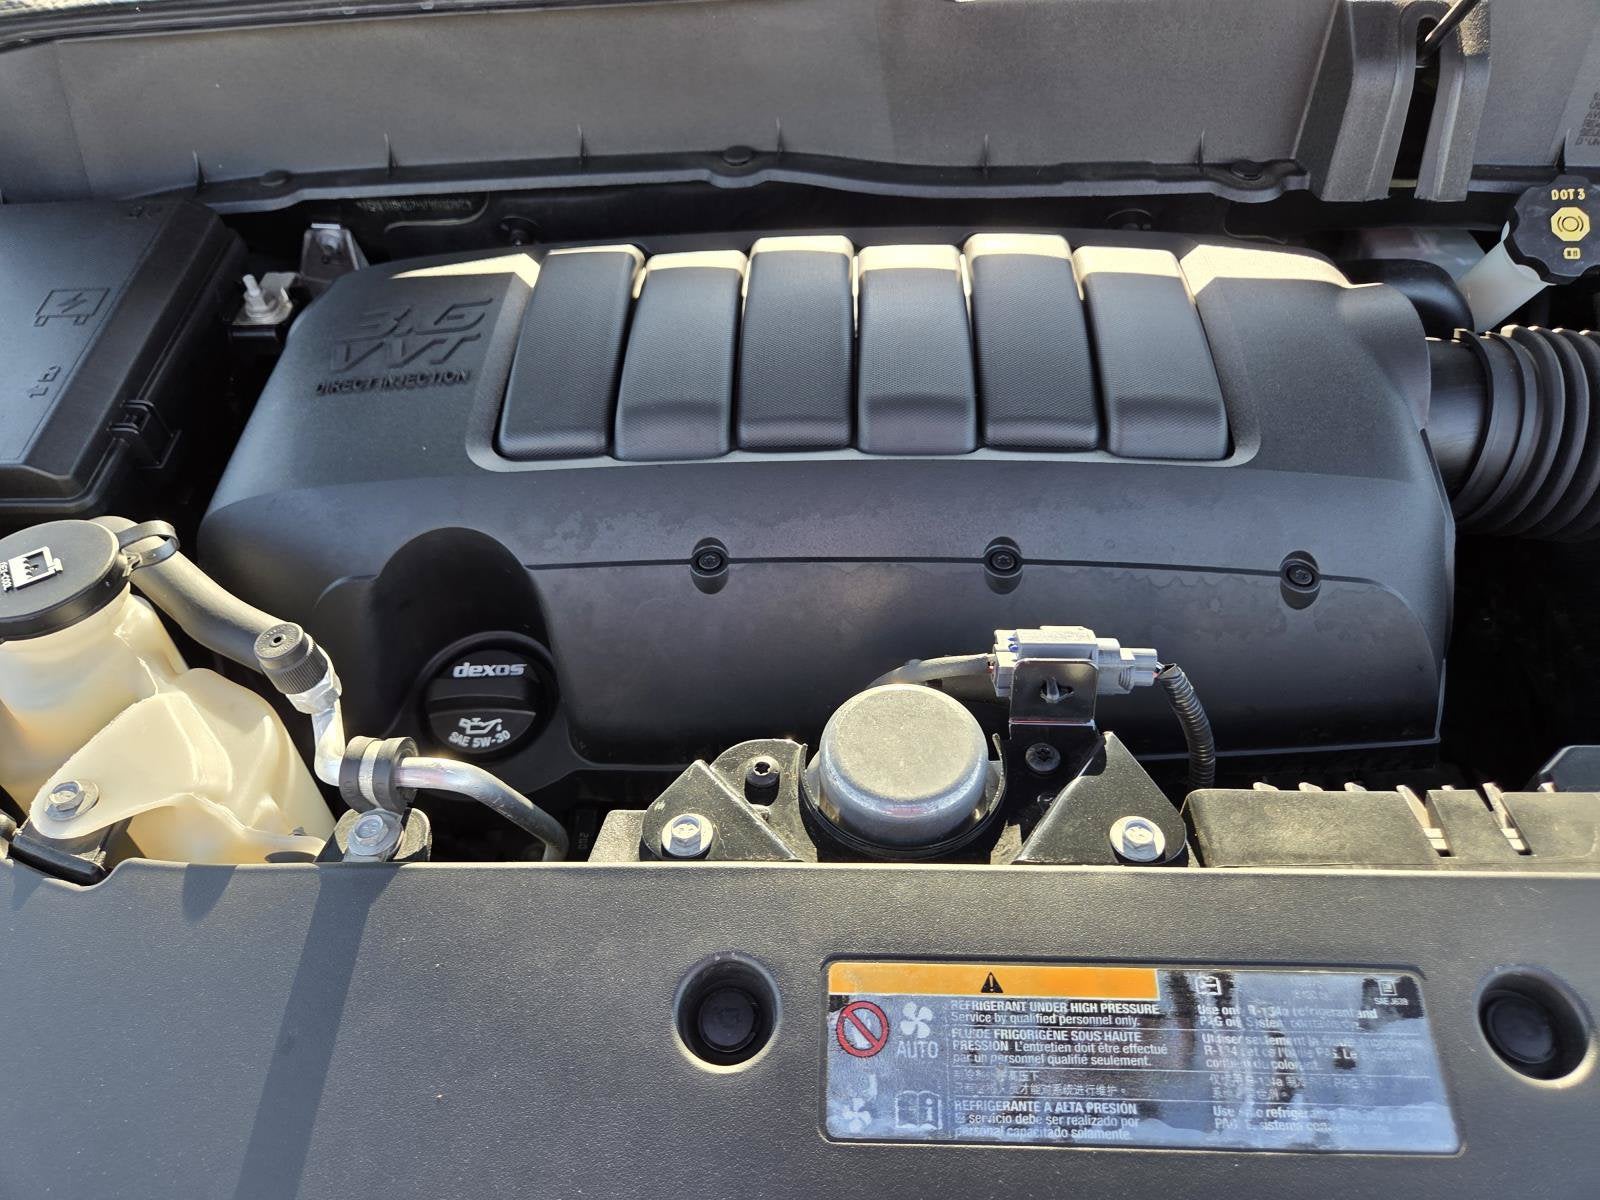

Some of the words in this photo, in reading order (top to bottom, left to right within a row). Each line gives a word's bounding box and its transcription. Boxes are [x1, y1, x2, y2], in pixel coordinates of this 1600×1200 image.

[1551, 189, 1575, 201] DOT
[1577, 188, 1586, 200] 3
[333, 297, 494, 345] 3.6
[330, 332, 482, 374] VVT
[315, 377, 381, 397] DIRECT
[381, 369, 472, 392] INJECTION
[452, 662, 528, 679] dexos
[448, 731, 471, 747] SAE
[472, 730, 512, 748] 5W-30
[951, 1000, 1026, 1012] REFRIGERANT
[1029, 1002, 1067, 1013] UNDER
[1070, 1003, 1098, 1014] HIGH
[1100, 1003, 1160, 1015] PRESSURE
[1197, 1004, 1219, 1016] Use
[1357, 1008, 1378, 1020] and
[951, 1012, 991, 1023] Service
[994, 1012, 1007, 1025] by
[1009, 1013, 1057, 1026] qualified
[1059, 1014, 1113, 1027] personnel
[1114, 1015, 1141, 1027] only.
[1070, 1030, 1101, 1042] SOUS
[1103, 1030, 1142, 1042] HAUTE
[897, 1041, 939, 1059] AUTO
[1014, 1041, 1073, 1053] L'entretien
[1074, 1042, 1096, 1053] doit
[1122, 1043, 1169, 1055] effectué
[990, 1054, 1044, 1066] personnel
[1047, 1054, 1089, 1067] qualifié
[1090, 1055, 1152, 1067] seulement.
[954, 1100, 1041, 1113] REFRIGERANTE
[1044, 1101, 1053, 1113] A
[1055, 1101, 1084, 1114] ALTA
[1086, 1101, 1138, 1115] PRESIÓN
[1212, 1105, 1235, 1117] Use
[968, 1113, 1012, 1124] servicio
[1015, 1113, 1042, 1125] debe
[1045, 1115, 1064, 1126] ser
[1066, 1115, 1117, 1127] realizado
[1120, 1118, 1140, 1130] por
[1006, 1126, 1069, 1139] capacitado
[1070, 1127, 1132, 1140] solamente.
